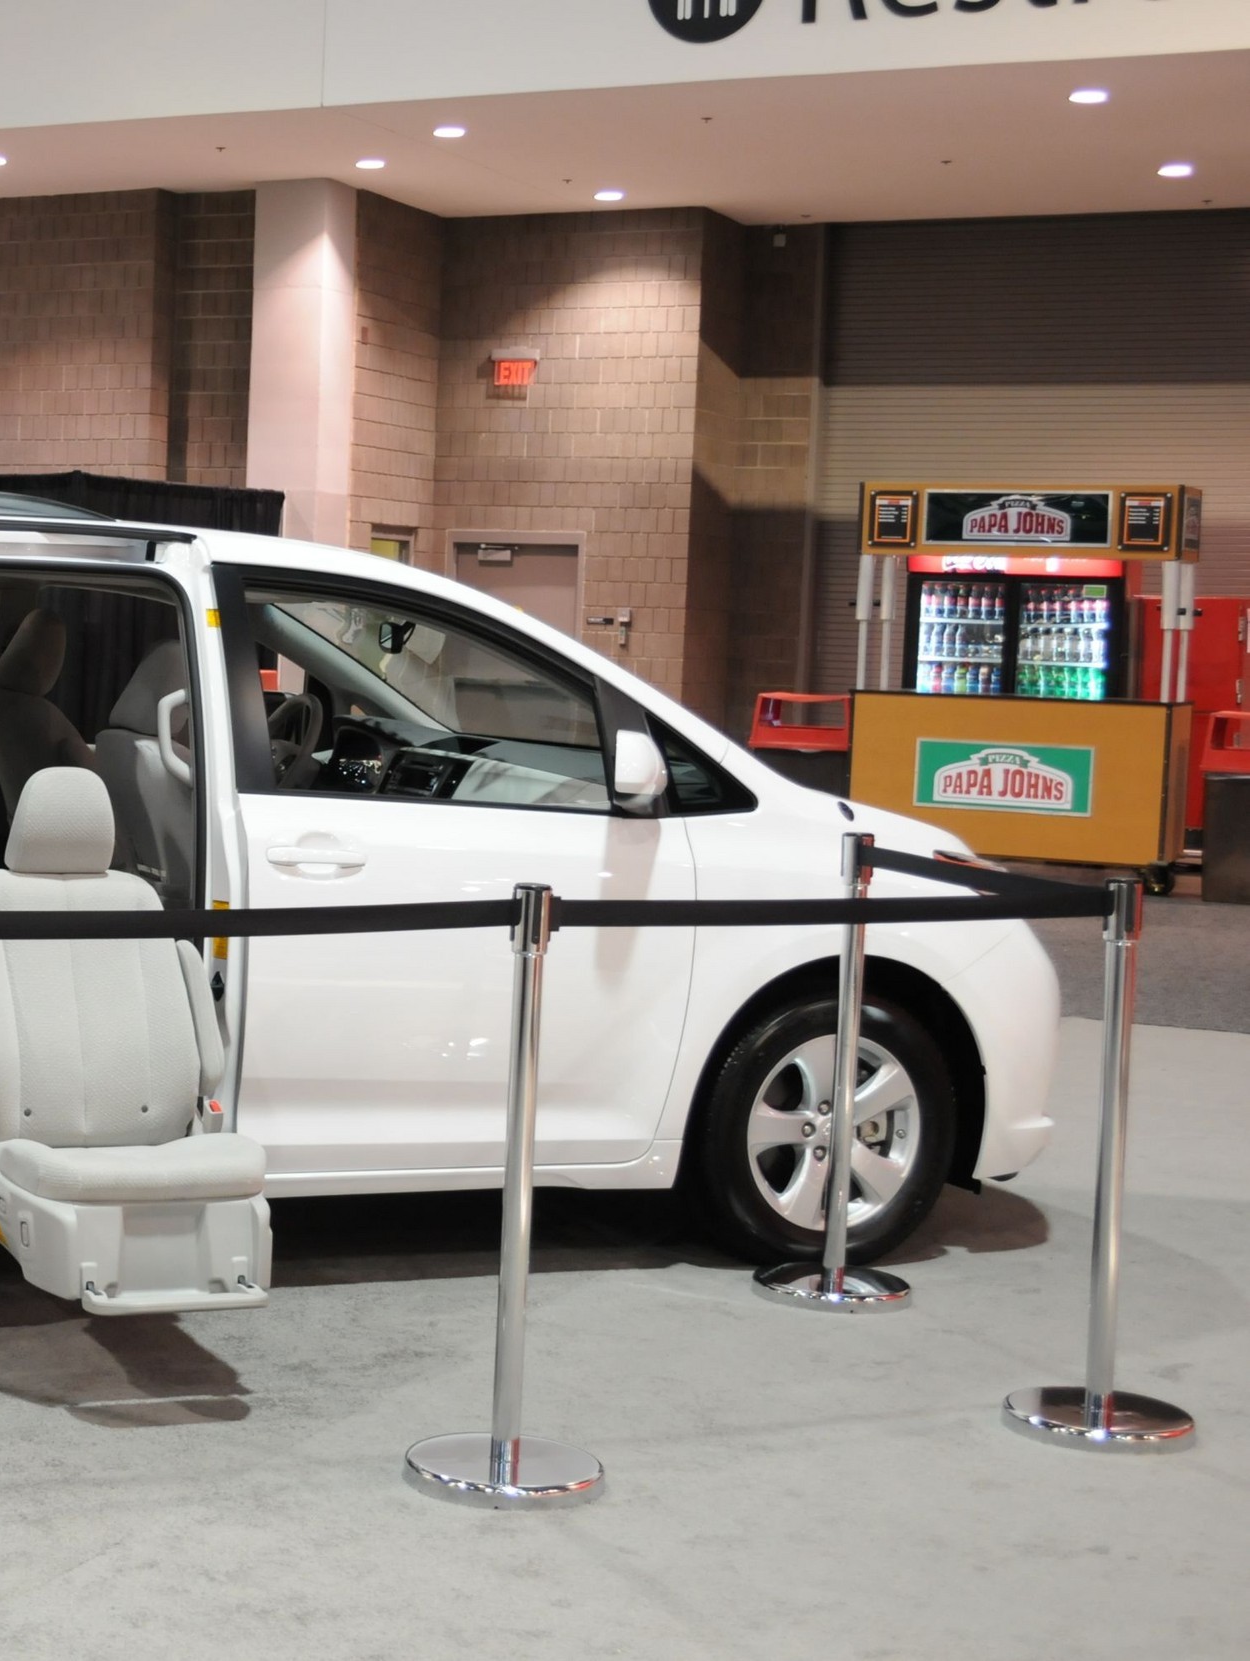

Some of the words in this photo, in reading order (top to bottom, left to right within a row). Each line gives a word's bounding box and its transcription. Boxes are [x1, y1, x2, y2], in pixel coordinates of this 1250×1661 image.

[500, 361, 533, 385] EXIT
[969, 511, 1009, 534] PAPA
[987, 753, 1021, 765] PIZZA
[942, 768, 993, 797] PAPA
